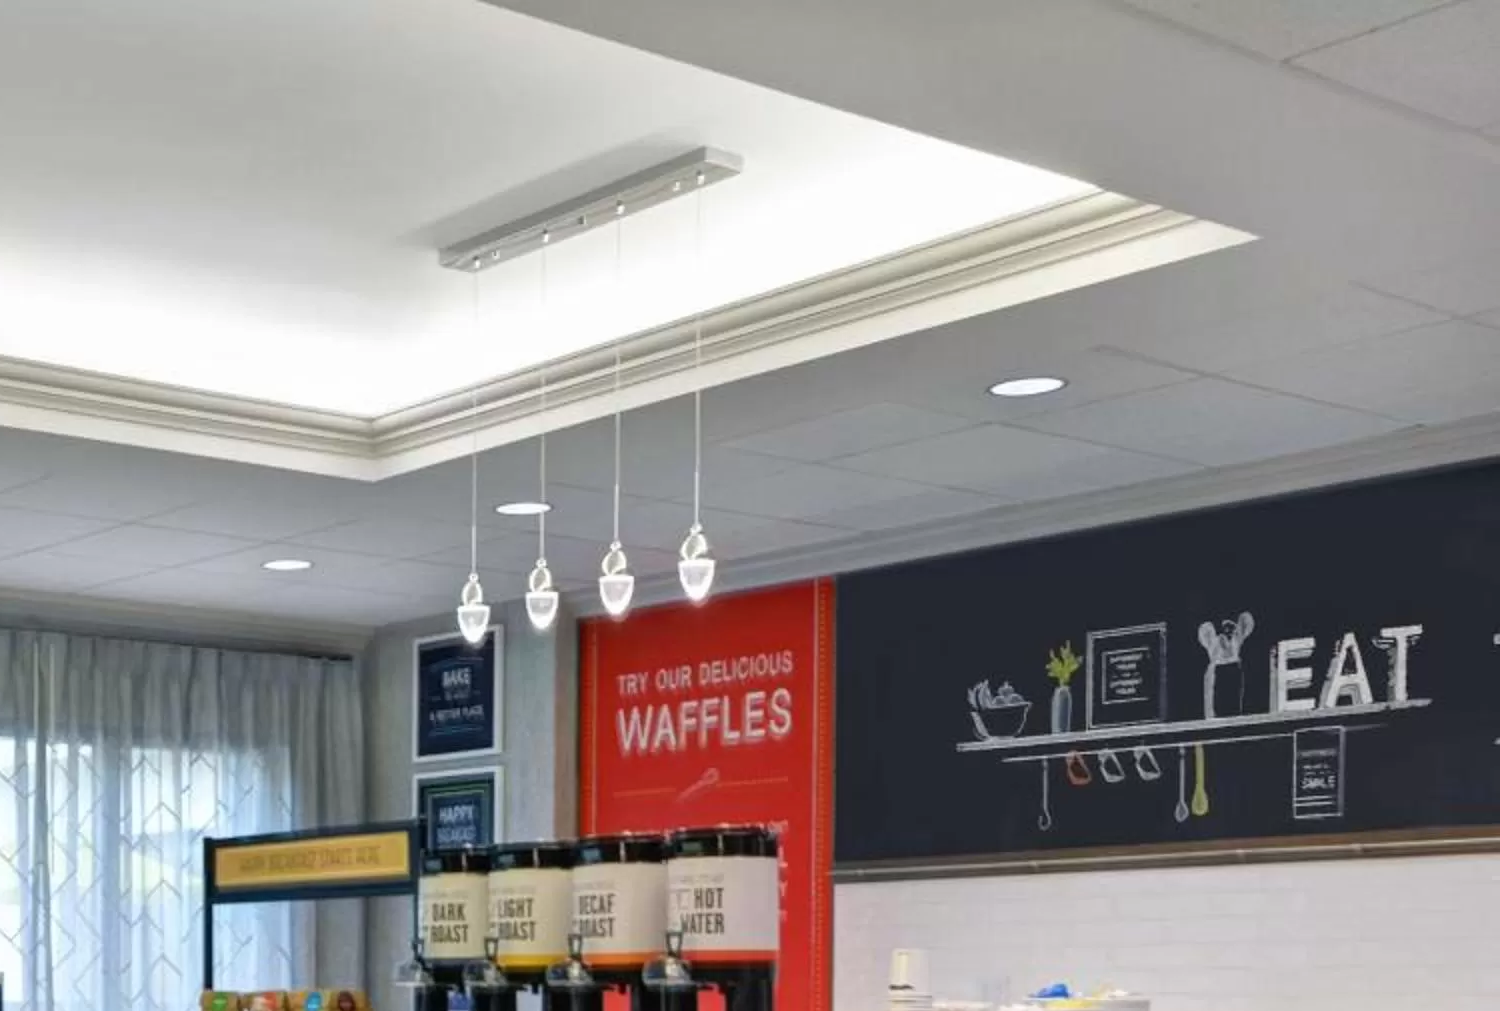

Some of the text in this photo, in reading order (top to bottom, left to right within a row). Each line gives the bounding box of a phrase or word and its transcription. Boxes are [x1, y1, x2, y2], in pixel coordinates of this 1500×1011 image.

[615, 648, 794, 698] TRY OUR DELICIOUS
[1269, 623, 1424, 714] EAT
[616, 686, 793, 757] WAFFLES
[497, 897, 535, 918] LIGHT
[578, 892, 616, 915] DECAF
[693, 887, 725, 910] HOT
[431, 902, 467, 922] DARK
[680, 911, 725, 935] WATER
[429, 923, 469, 944] ROAST
[498, 921, 537, 943] ROAST
